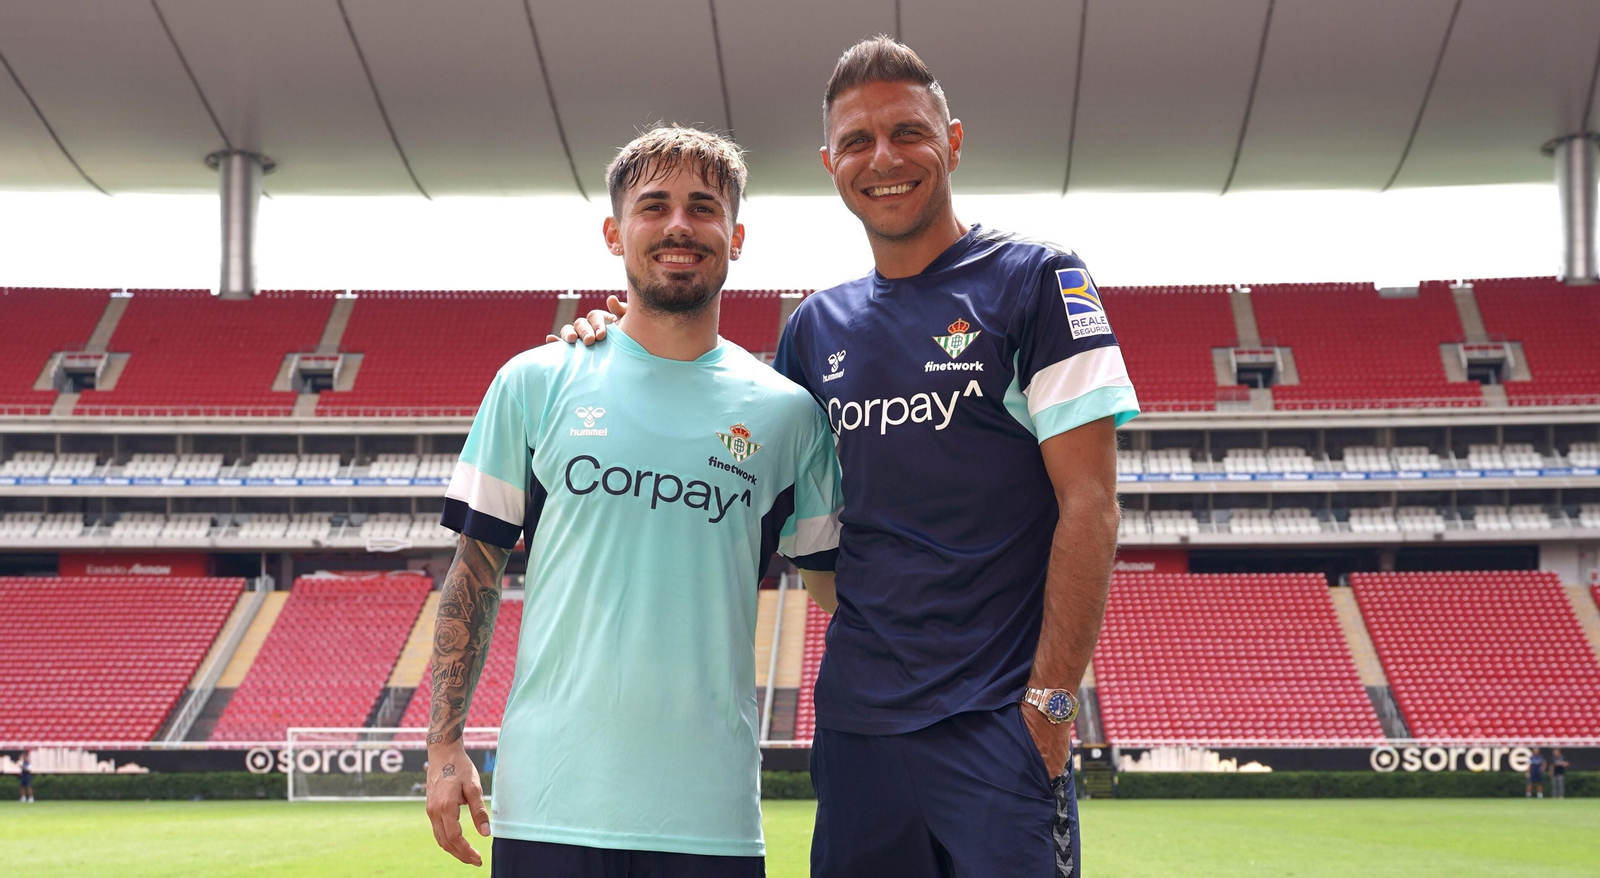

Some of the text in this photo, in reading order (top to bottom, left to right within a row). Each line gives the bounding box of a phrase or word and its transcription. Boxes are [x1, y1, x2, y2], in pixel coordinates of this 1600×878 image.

[1071, 316, 1107, 329] REALE
[1073, 326, 1110, 336] SEGUROS
[924, 361, 984, 372] finetwork
[570, 427, 608, 437] hummel
[708, 456, 757, 485] finetwork
[277, 749, 404, 774] sorare
[1402, 747, 1534, 772] sorare
